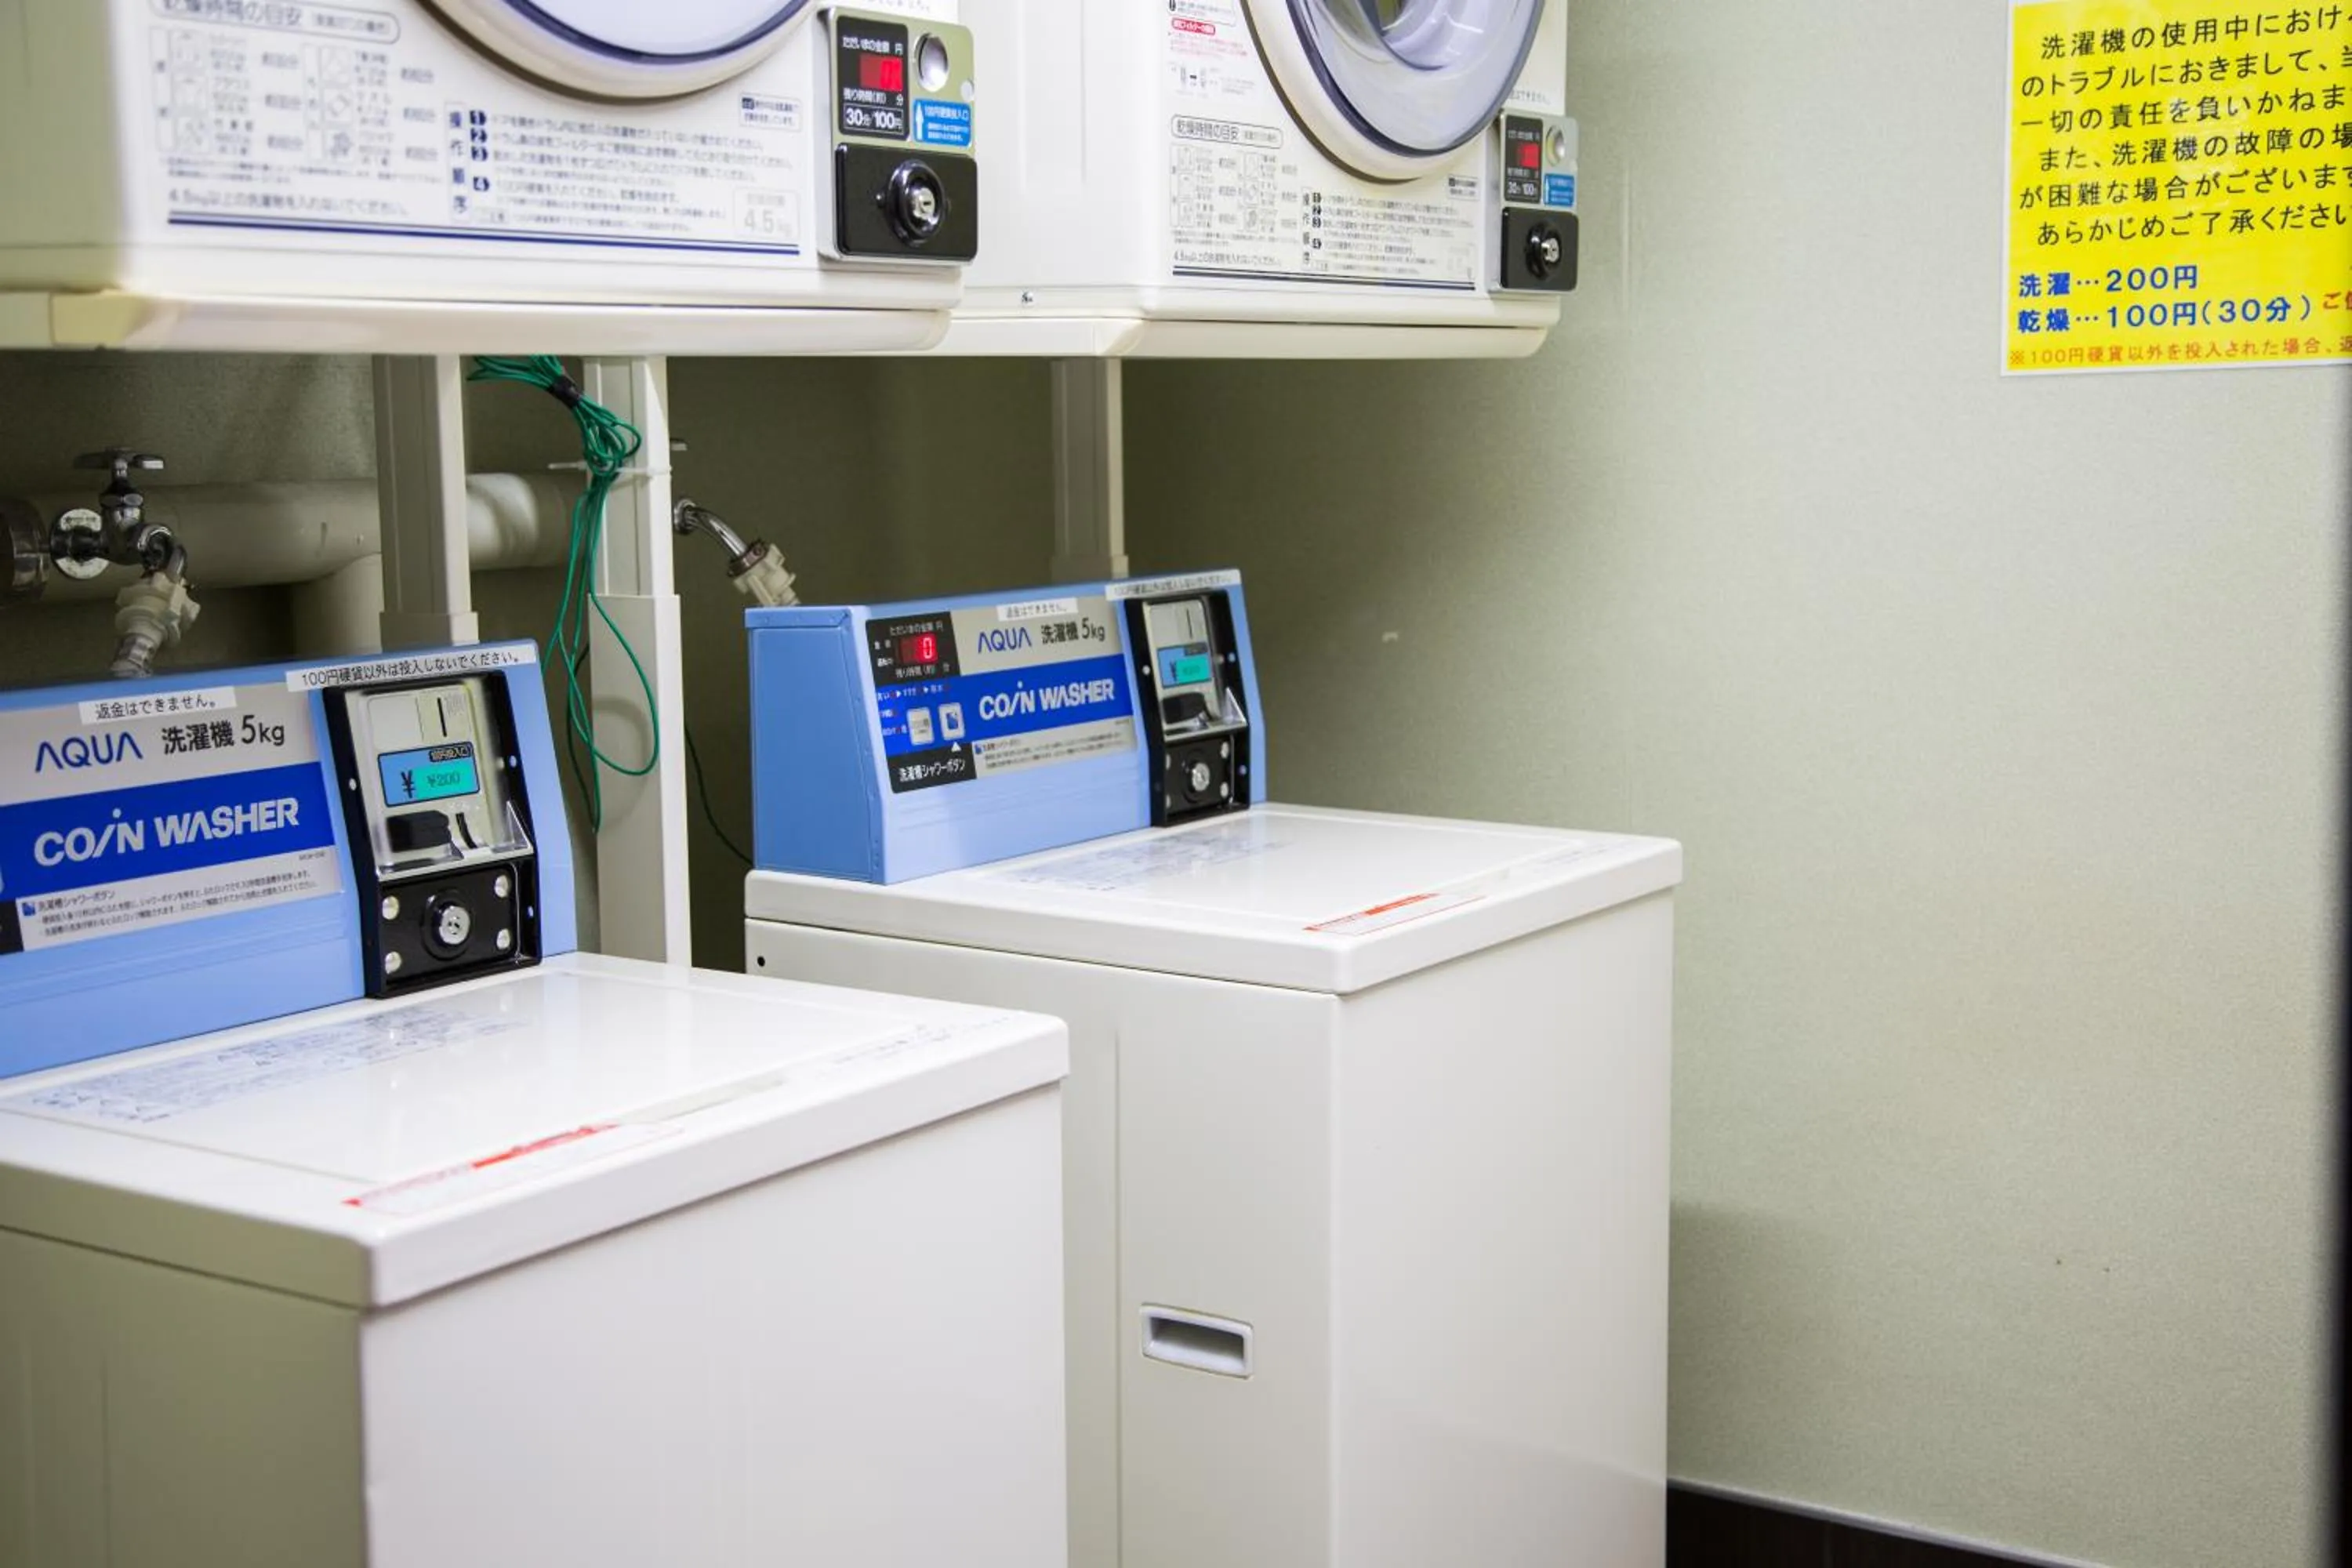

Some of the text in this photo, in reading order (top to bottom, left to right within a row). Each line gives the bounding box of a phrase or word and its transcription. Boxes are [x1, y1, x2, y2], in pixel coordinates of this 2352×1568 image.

[2042, 4, 2352, 60] 洗濯機の使用中におけ
[2020, 84, 2351, 133] 一切の責任を負いかねま
[2039, 121, 2352, 172] また、洗濯機の故障の場
[922, 637, 933, 659] 0
[978, 626, 1033, 654] AQUA
[1040, 616, 1105, 645] 洗濯機 5kg
[302, 652, 519, 687] 100円硬貨以外は投入しないでください。
[96, 694, 216, 720] 返金はできません。
[978, 681, 1034, 720] COIN
[1039, 678, 1115, 709] WASHER
[35, 731, 143, 773] AQUA
[162, 714, 285, 755] 洗濯機 5kg
[34, 797, 299, 867] COIN WASHER
